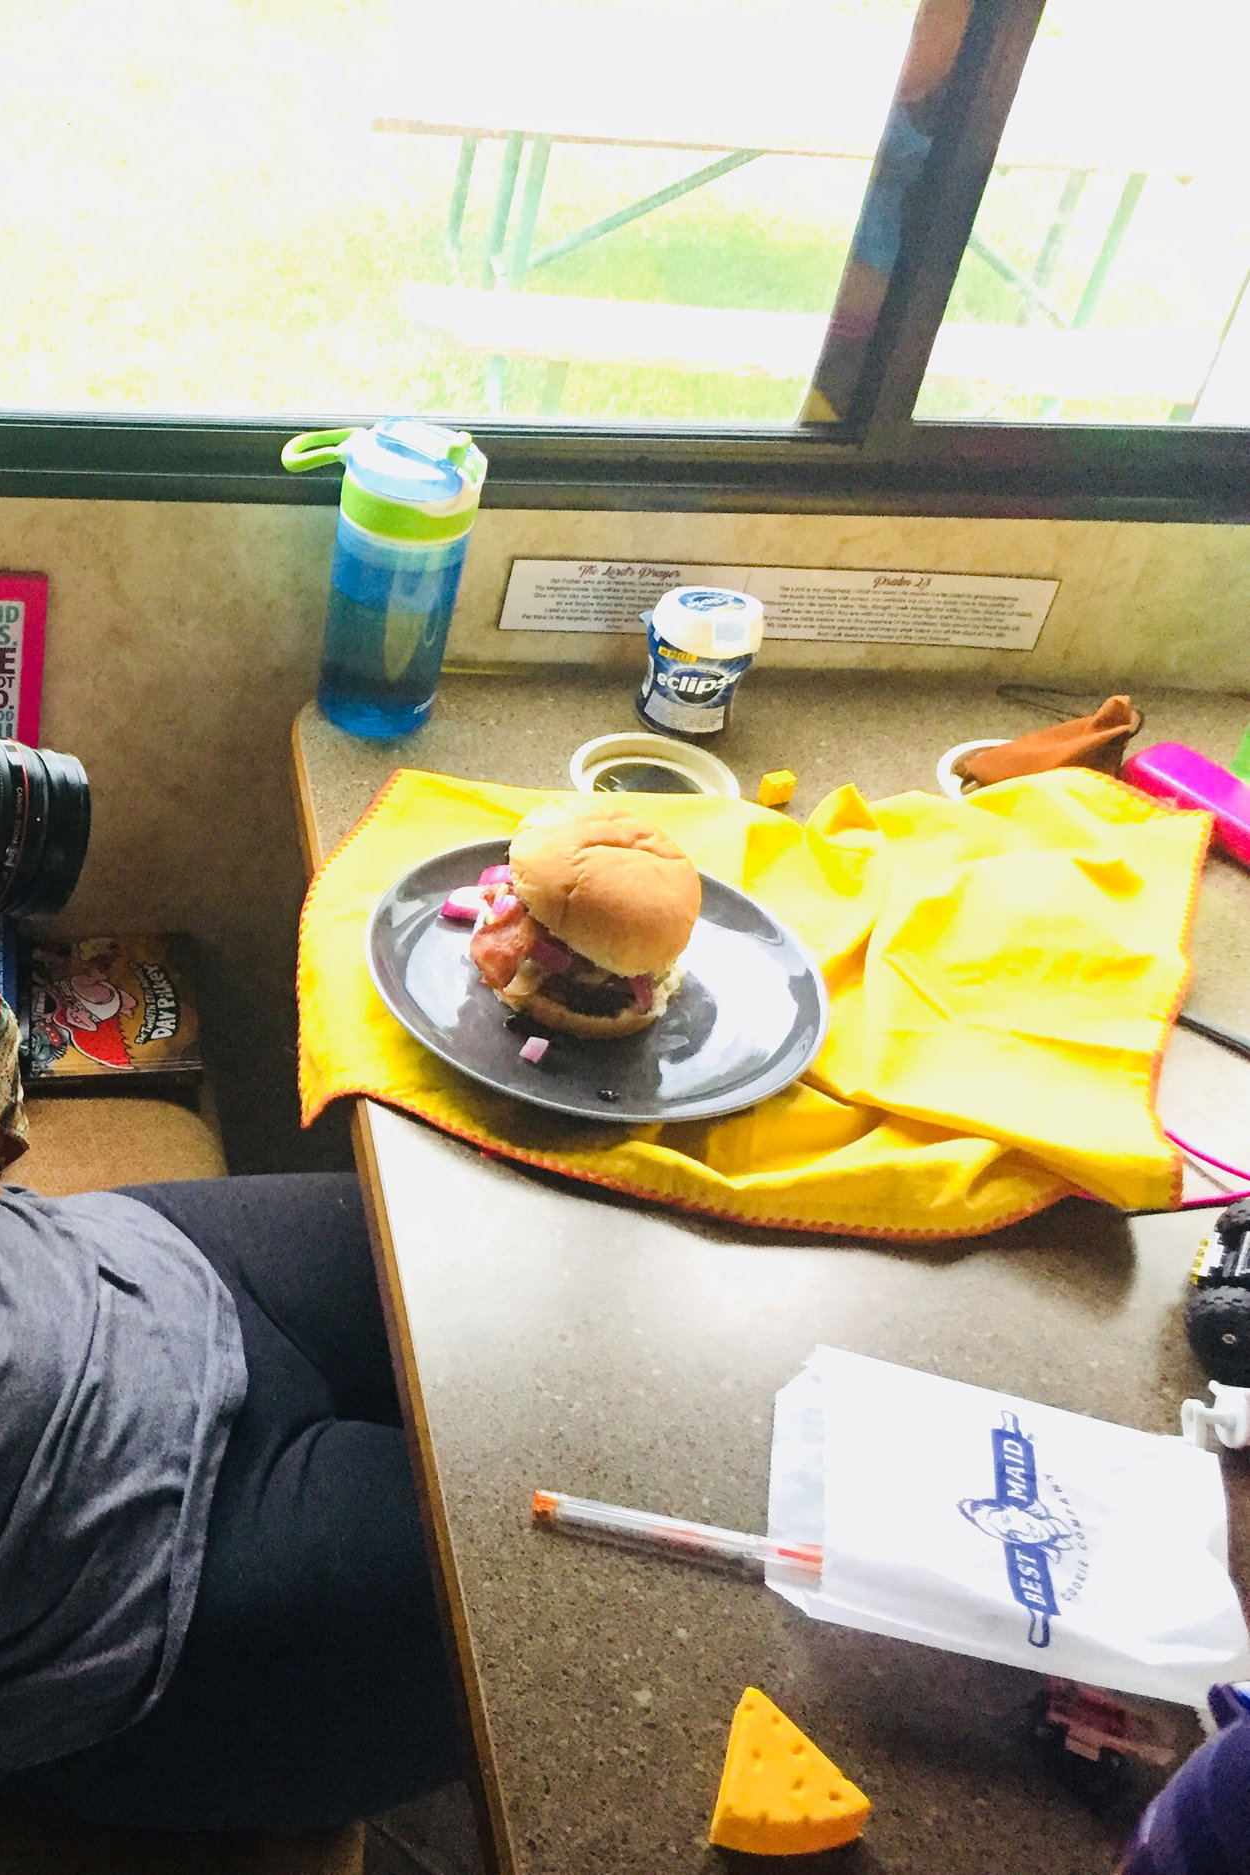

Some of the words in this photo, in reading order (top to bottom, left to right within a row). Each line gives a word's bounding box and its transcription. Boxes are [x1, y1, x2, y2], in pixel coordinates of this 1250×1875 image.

[150, 1010, 176, 1040] DAV
[1003, 1439, 1028, 1502] MAID
[1015, 1548, 1047, 1607] BEST
[1060, 1559, 1089, 1601] COOKIE
